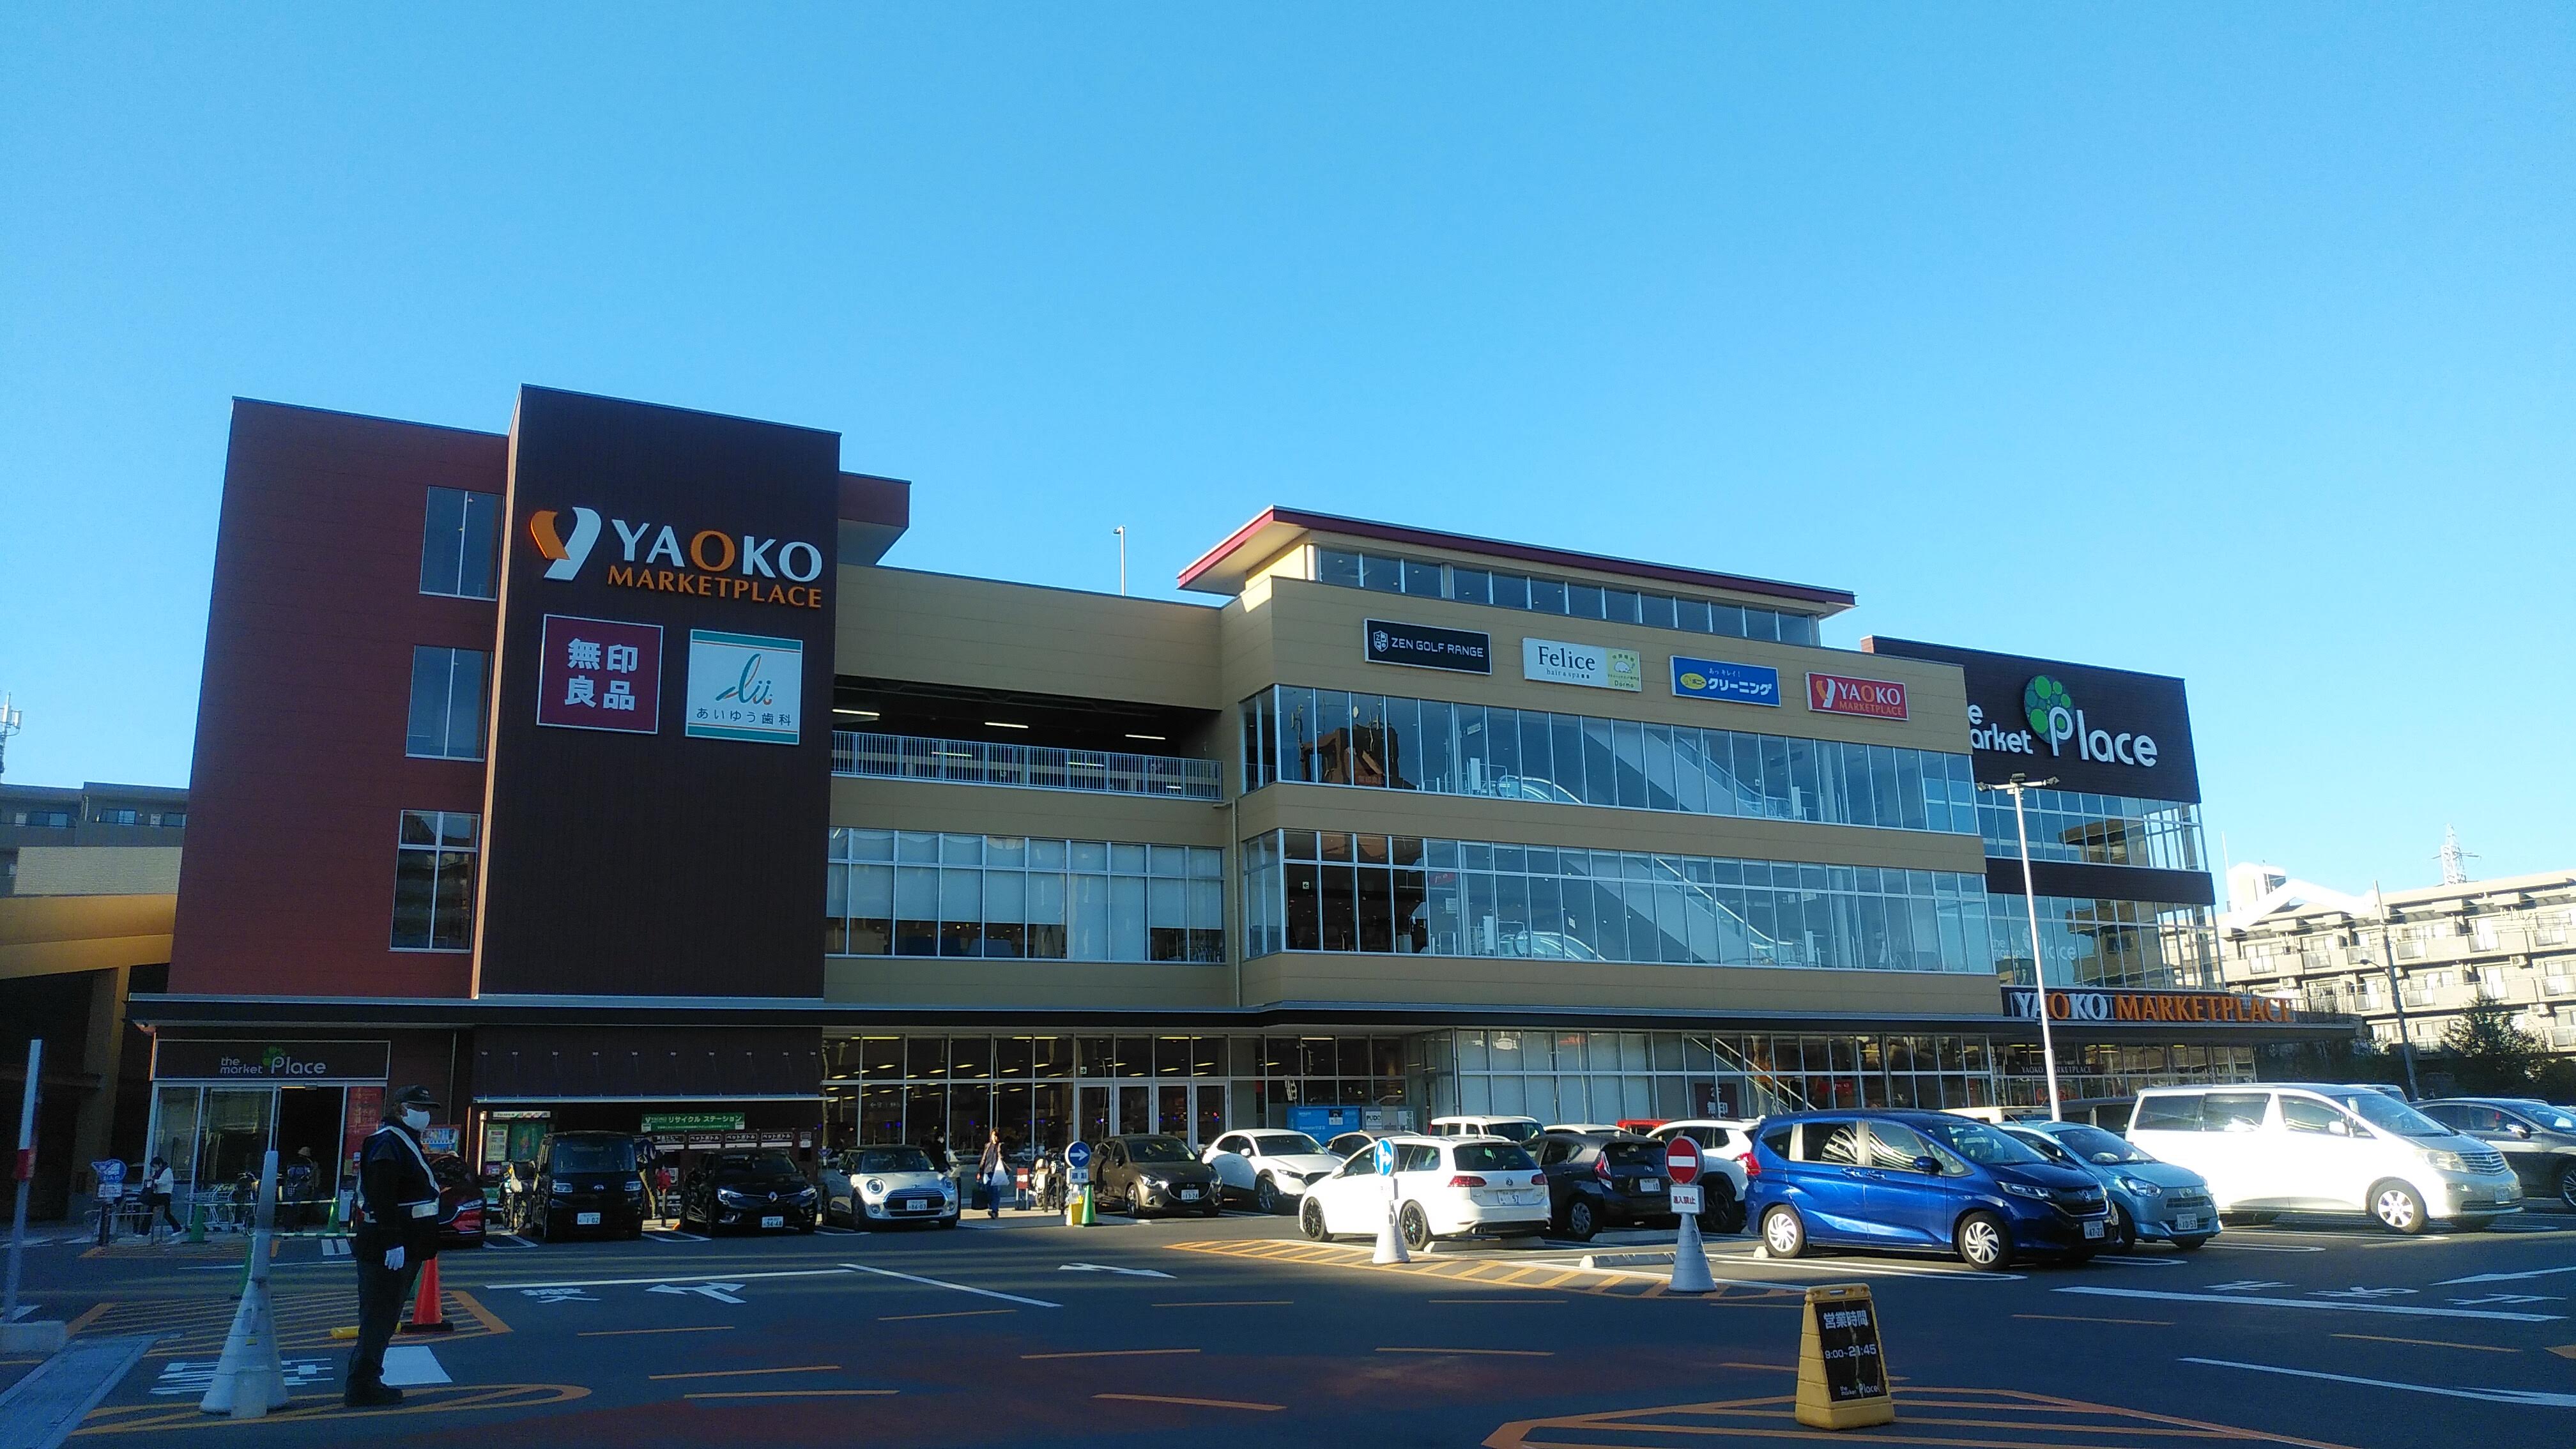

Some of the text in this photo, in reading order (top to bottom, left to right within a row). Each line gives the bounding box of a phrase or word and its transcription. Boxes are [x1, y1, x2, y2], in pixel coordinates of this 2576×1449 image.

[612, 519, 822, 582] YAOKO
[608, 565, 822, 609] MARKETPLACE
[568, 639, 638, 674] 無印
[1392, 638, 1483, 658] ZEN GOLF RANGE
[1538, 645, 1595, 671] Felice
[564, 675, 636, 711] 良品
[1708, 678, 1772, 696] クリーニング
[1837, 682, 1901, 705] YAOKO
[696, 707, 792, 726] あいゆう歯科
[1839, 701, 1902, 716] MARKETPLACE
[1969, 723, 2034, 755] arket
[2048, 706, 2158, 767] Place
[2115, 994, 2294, 1022] MARKETPLACE
[220, 1057, 240, 1066] the
[220, 1064, 263, 1074] market
[271, 1056, 326, 1074] Place
[2052, 1066, 2091, 1074] RKETPLACE
[1823, 1310, 1868, 1330] 営業時間
